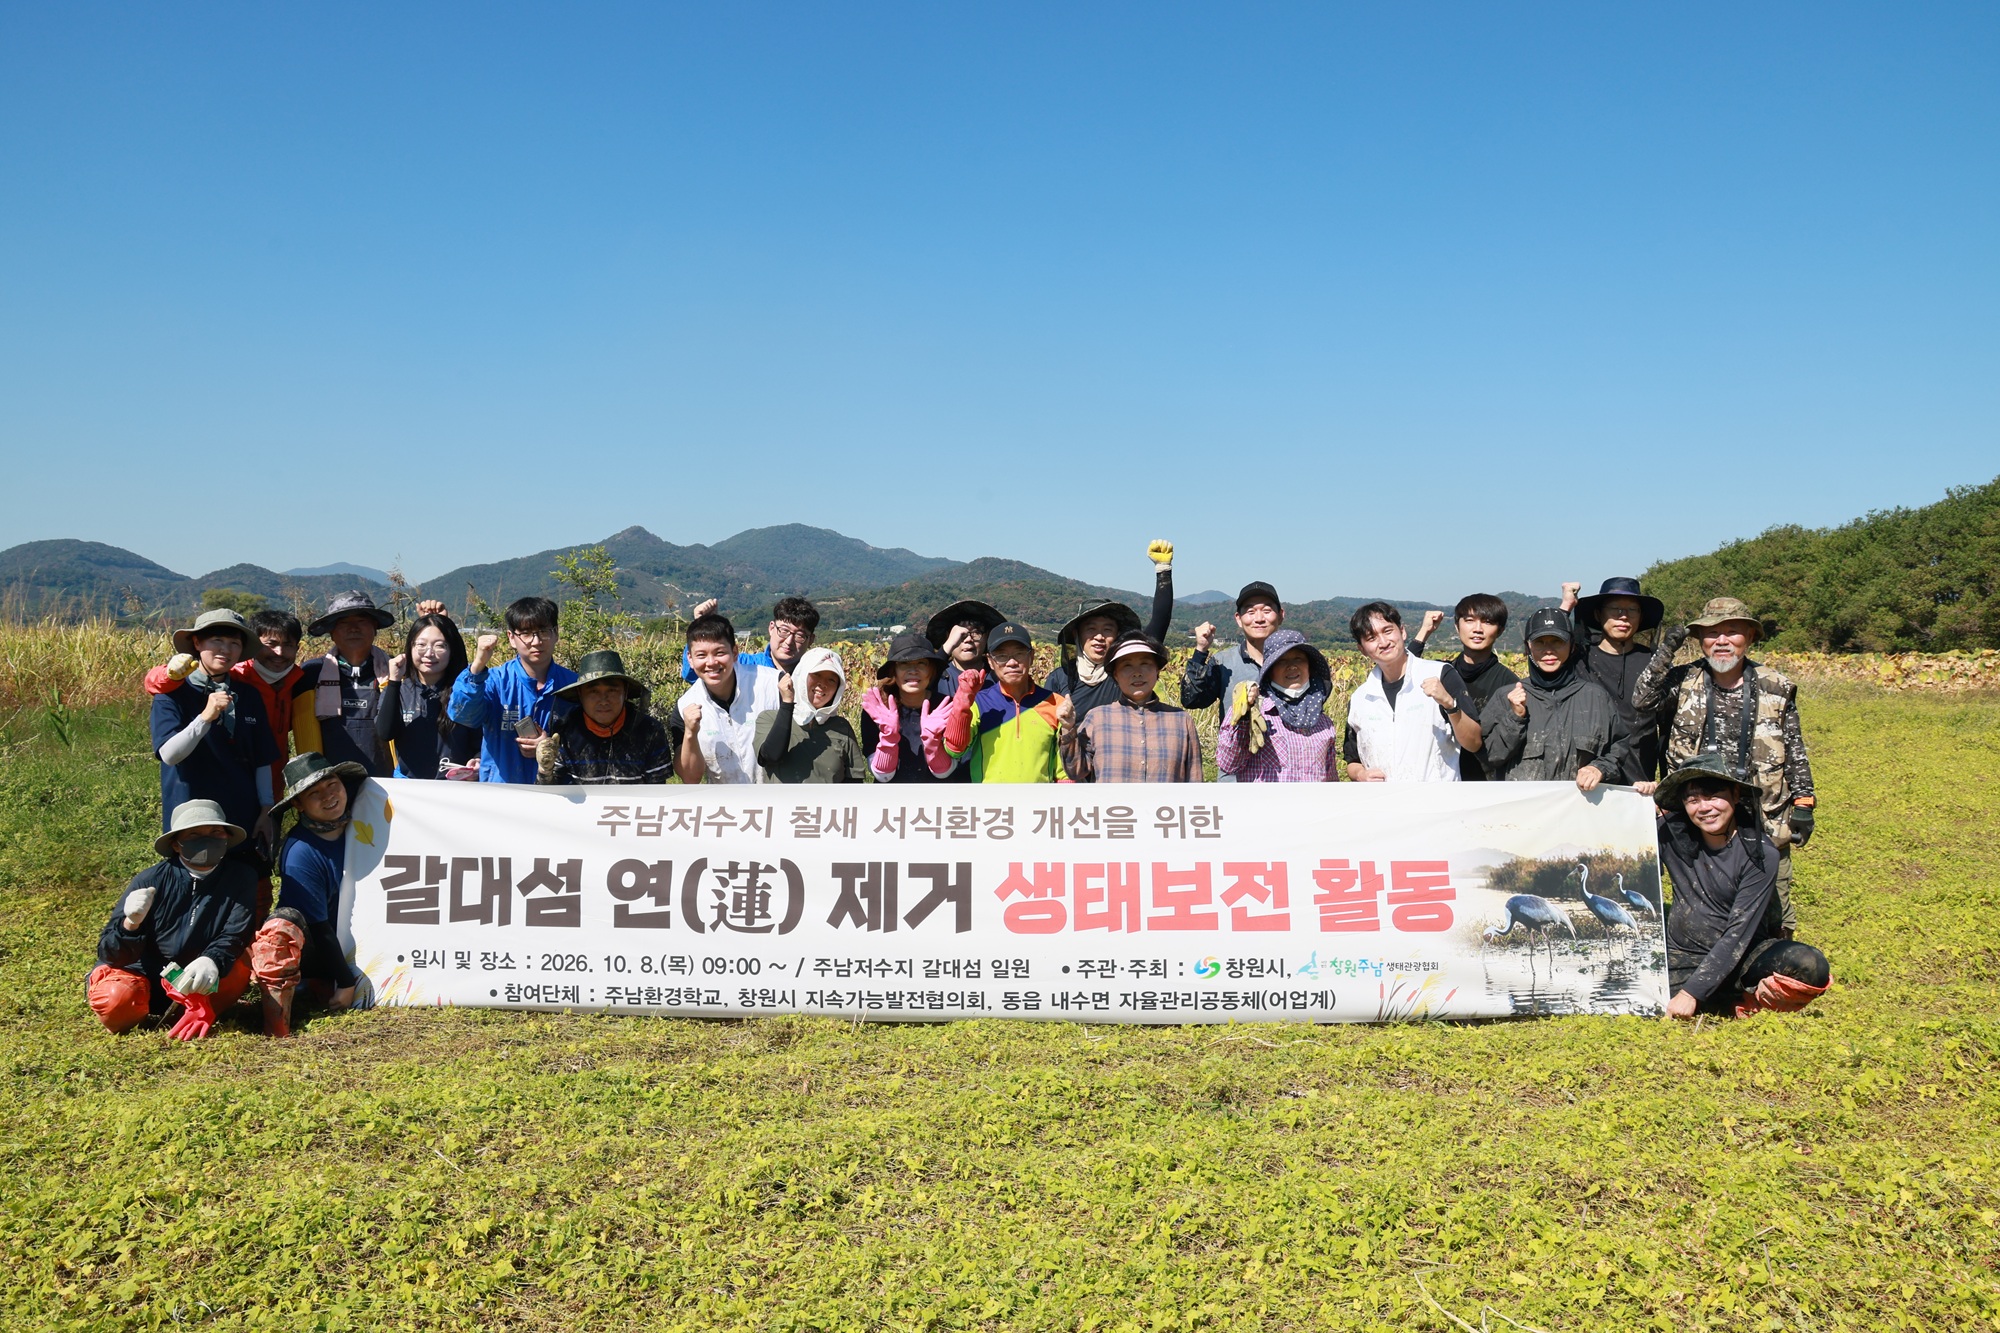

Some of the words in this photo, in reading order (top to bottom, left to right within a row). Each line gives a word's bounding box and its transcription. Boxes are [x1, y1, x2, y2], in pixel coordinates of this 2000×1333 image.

[597, 806, 773, 838] 주남저수지
[790, 807, 857, 839] 철새
[874, 807, 1014, 839] 서식환경
[1032, 806, 1137, 839] 개선을
[1154, 806, 1223, 839] 위한
[380, 855, 583, 927] 갈대섬
[607, 858, 804, 935] 연(蓮)
[826, 862, 971, 933] 제거
[995, 862, 1290, 933] 생태보전
[1313, 860, 1456, 932] 활동
[411, 950, 445, 969] 일시
[455, 951, 470, 969] 및
[480, 952, 516, 970] 장소
[541, 954, 593, 972] 2026.
[604, 955, 631, 973] 10.
[641, 955, 693, 975] 8.(목)
[703, 956, 760, 975] 09:00
[814, 958, 912, 979] 주남저수지
[923, 959, 980, 979] 갈대섬
[991, 959, 1029, 979] 일원
[1077, 959, 1166, 979] 주관·주최
[1226, 958, 1291, 979] 창원시,
[1329, 957, 1383, 977] 창원주남
[1386, 962, 1439, 972] 생태관광협회
[504, 983, 580, 1004] 참여단체
[604, 986, 729, 1008] 주남환경학교,
[739, 989, 795, 1008] 창원시
[806, 989, 992, 1012] 지속가능발전협의회,
[1002, 992, 1041, 1010] 동읍
[1052, 992, 1109, 1010] 내수면
[1119, 990, 1335, 1010] 자율관리공동체(어업계)
